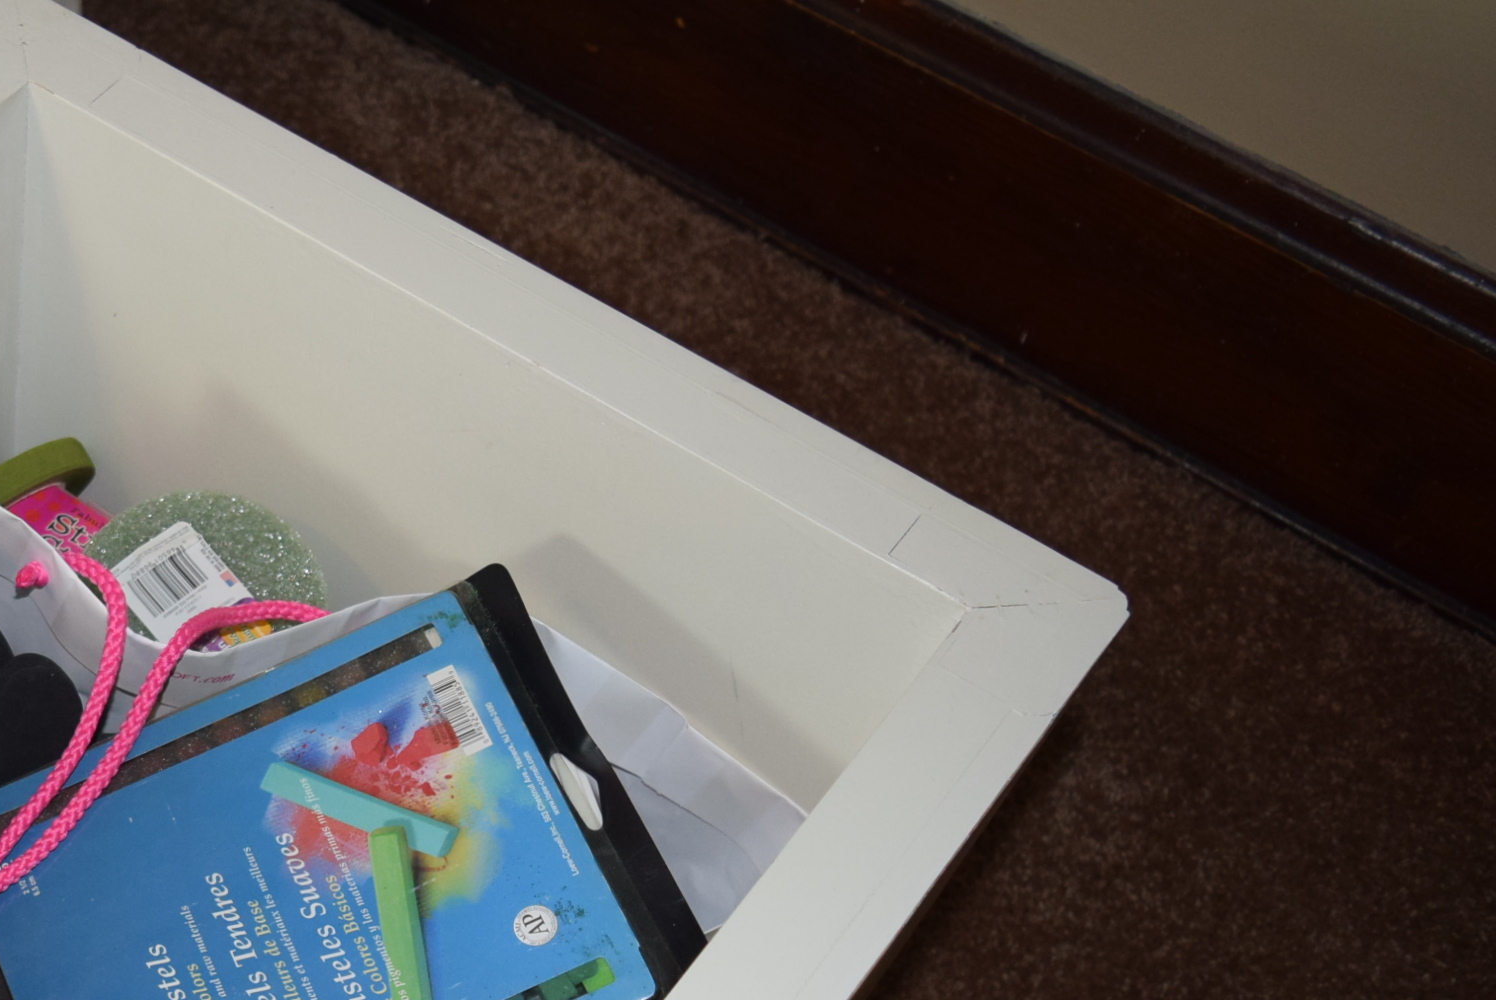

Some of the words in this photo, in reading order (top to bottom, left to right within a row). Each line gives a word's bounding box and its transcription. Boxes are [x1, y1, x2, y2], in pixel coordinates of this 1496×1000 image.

[48, 513, 93, 549] St
[173, 672, 236, 684] OFT.com
[300, 778, 317, 803] finos
[528, 784, 546, 811] Chestnut
[309, 804, 327, 825] más
[322, 826, 346, 861] primas
[243, 847, 269, 893] meilleurs
[276, 829, 327, 919] Suaves
[337, 860, 365, 907] materias
[248, 901, 272, 937] Base
[264, 894, 277, 910] les
[325, 873, 360, 934] Básicos
[360, 908, 374, 925] las
[180, 905, 208, 954] materials
[205, 873, 258, 968] Tendres
[272, 911, 300, 963] matériaux
[522, 914, 550, 935] AP
[264, 940, 281, 957] de
[354, 936, 388, 995] Colores
[375, 935, 406, 988] pigmentos
[203, 956, 218, 977] raw
[294, 964, 306, 975] et
[209, 978, 227, 998] and
